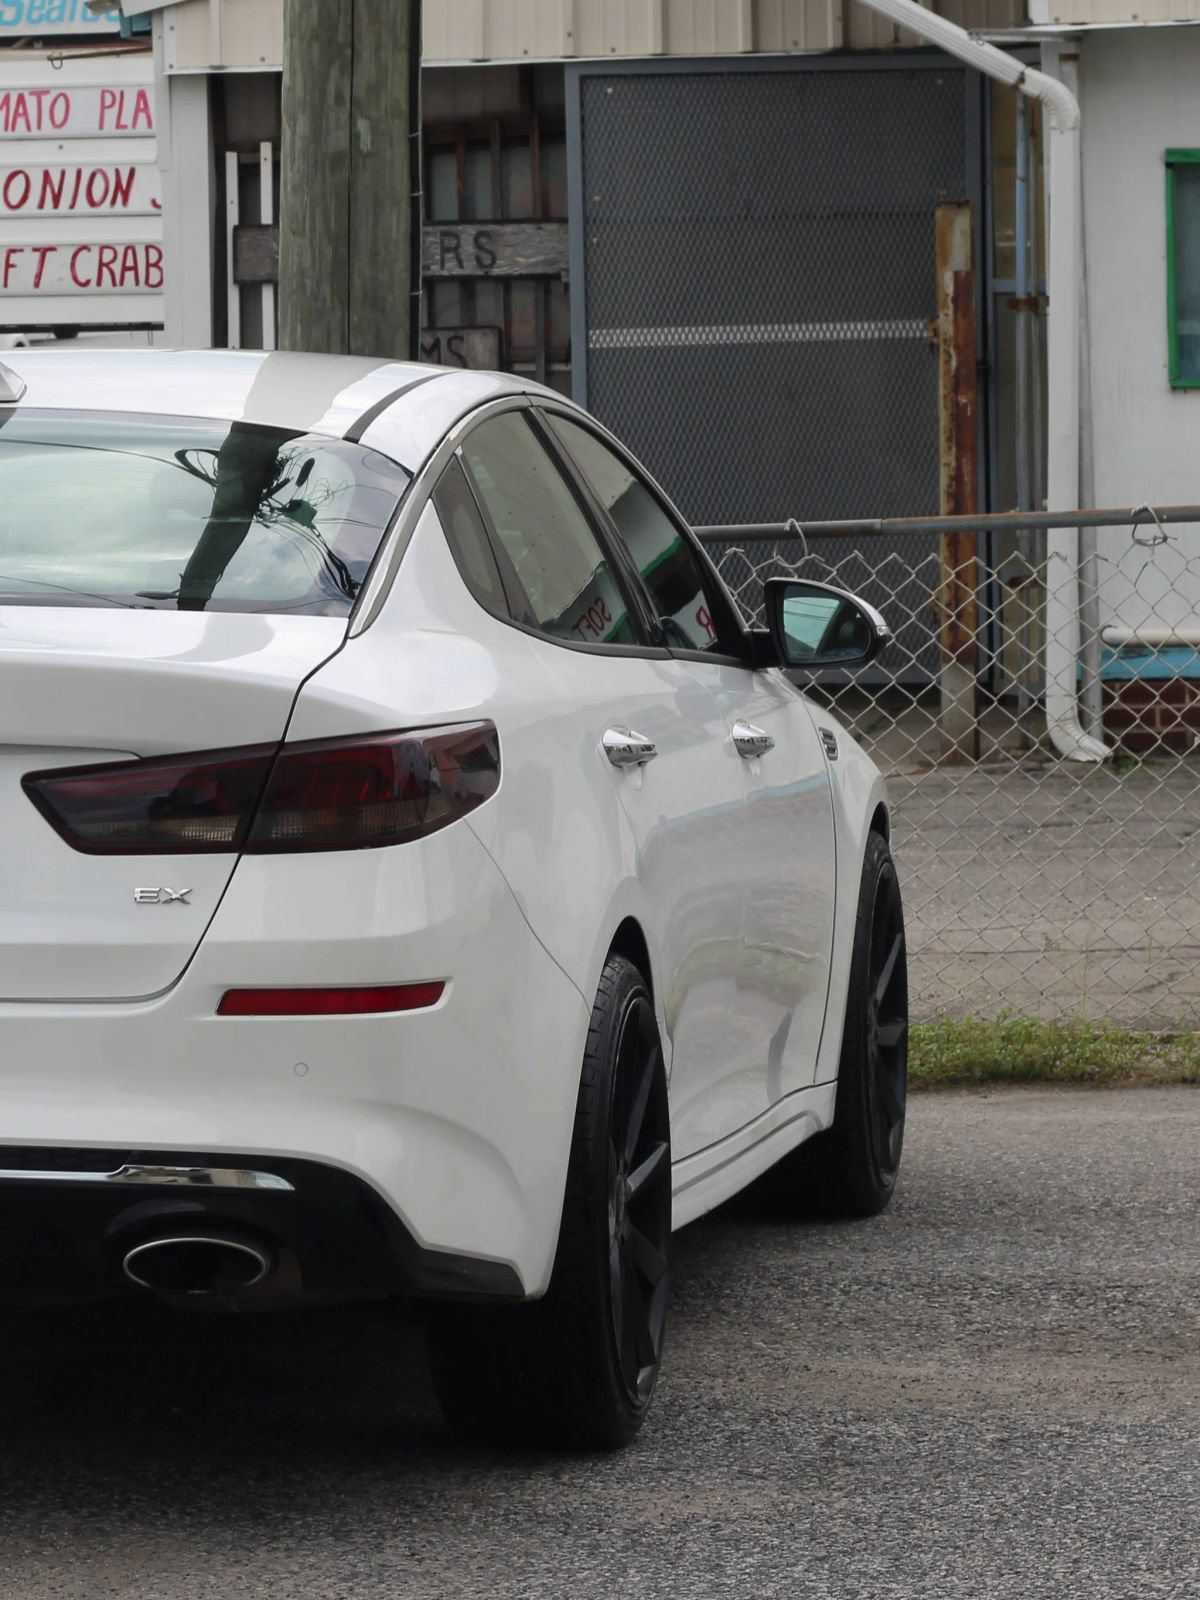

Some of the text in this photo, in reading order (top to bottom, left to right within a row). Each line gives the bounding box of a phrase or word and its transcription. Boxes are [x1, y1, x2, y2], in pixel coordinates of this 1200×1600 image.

[98, 88, 154, 131] PLA
[3, 166, 136, 210] ONION
[70, 244, 164, 288] CRAB
[422, 229, 498, 270] RS
[134, 887, 193, 905] EX
